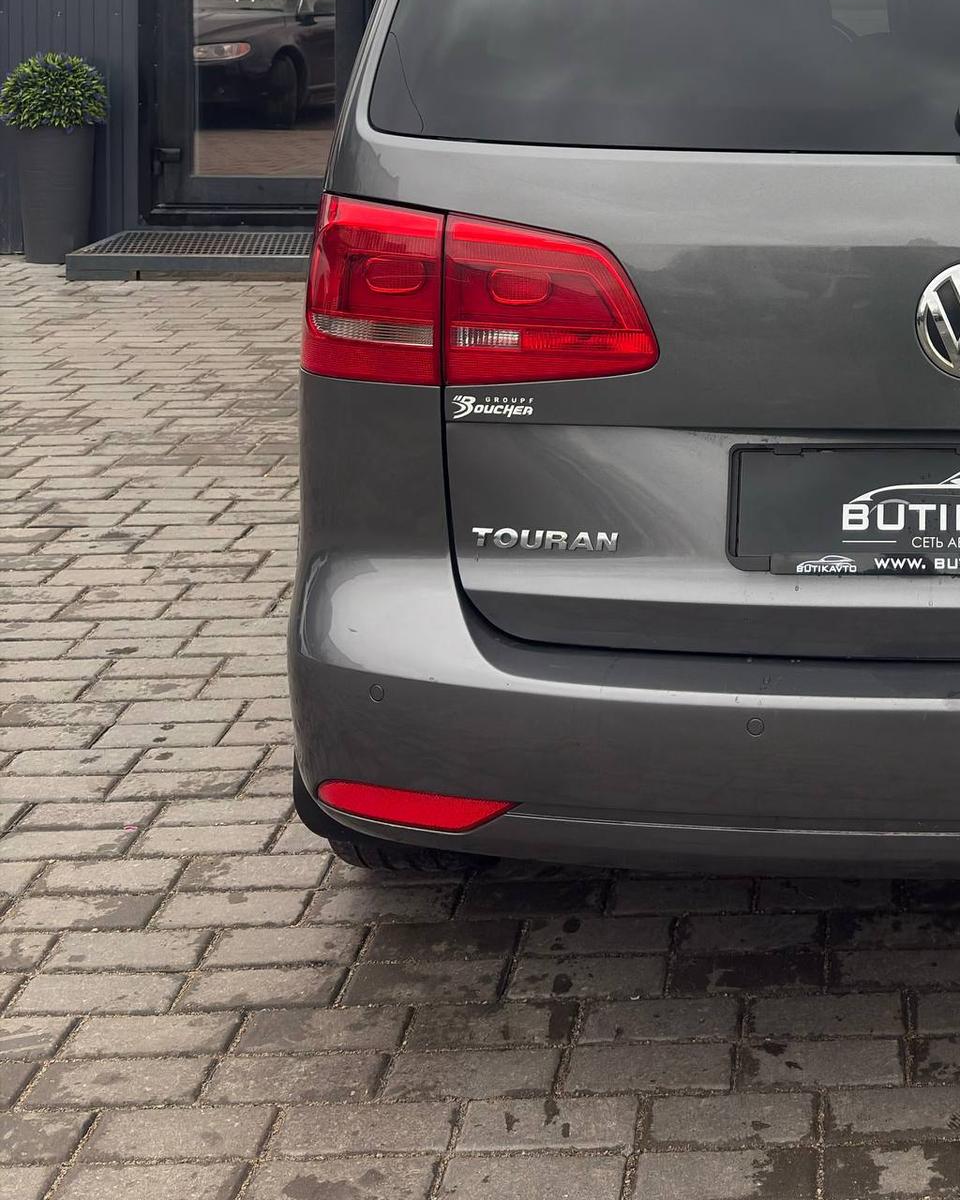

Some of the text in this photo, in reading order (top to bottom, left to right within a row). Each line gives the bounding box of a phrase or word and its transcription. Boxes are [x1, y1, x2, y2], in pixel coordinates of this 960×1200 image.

[452, 395, 534, 419] BOUCHER
[472, 526, 619, 551] TOURAN
[911, 536, 944, 549] СЕТЬ
[796, 564, 857, 574] BUTIKAVTO
